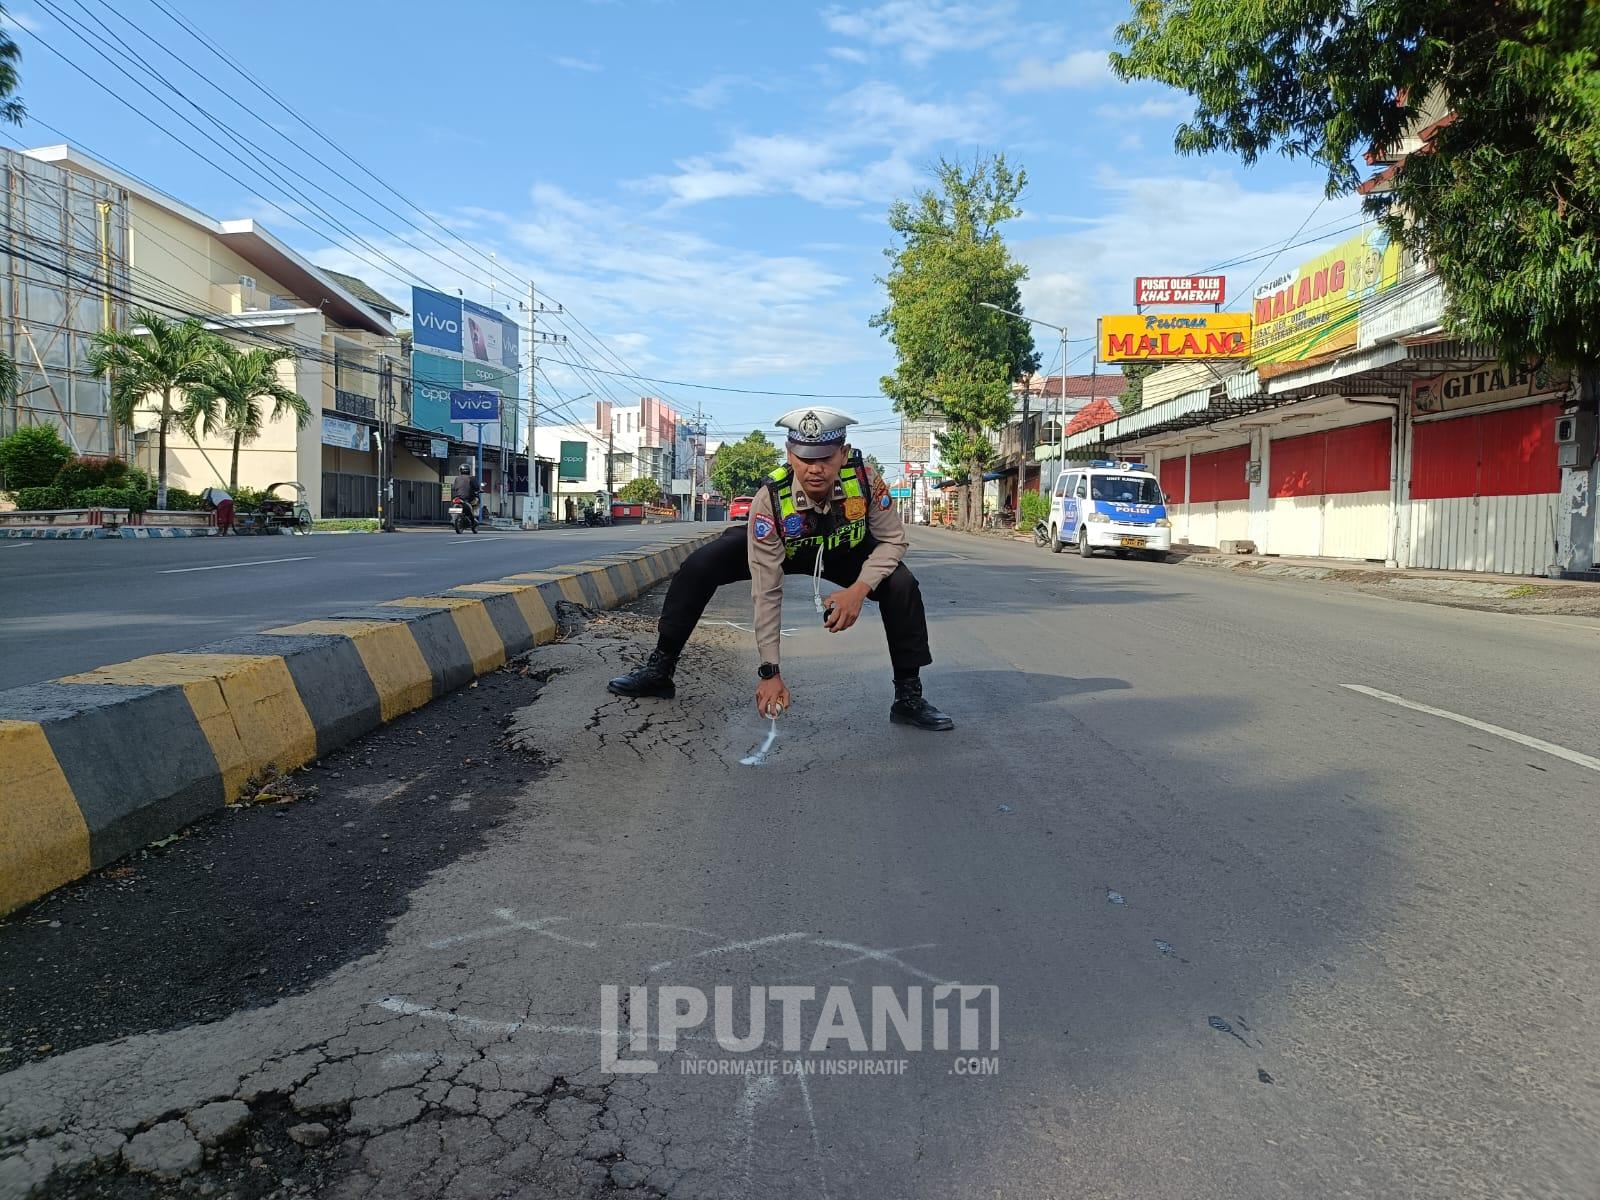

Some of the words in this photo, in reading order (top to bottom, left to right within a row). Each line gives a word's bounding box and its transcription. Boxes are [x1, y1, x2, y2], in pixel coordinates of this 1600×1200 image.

[1141, 279, 1170, 290] PUSAT
[1170, 279, 1192, 289] OLEH
[1198, 278, 1219, 289] OLEH
[1140, 290, 1171, 302] KHAS
[1173, 290, 1220, 302] DAERAH
[1256, 260, 1345, 325] MALANG
[417, 312, 458, 333] vivo
[1145, 315, 1207, 330] Restoran
[1108, 332, 1247, 356] MALANG
[476, 369, 494, 380] oppo
[457, 398, 492, 410] vivo
